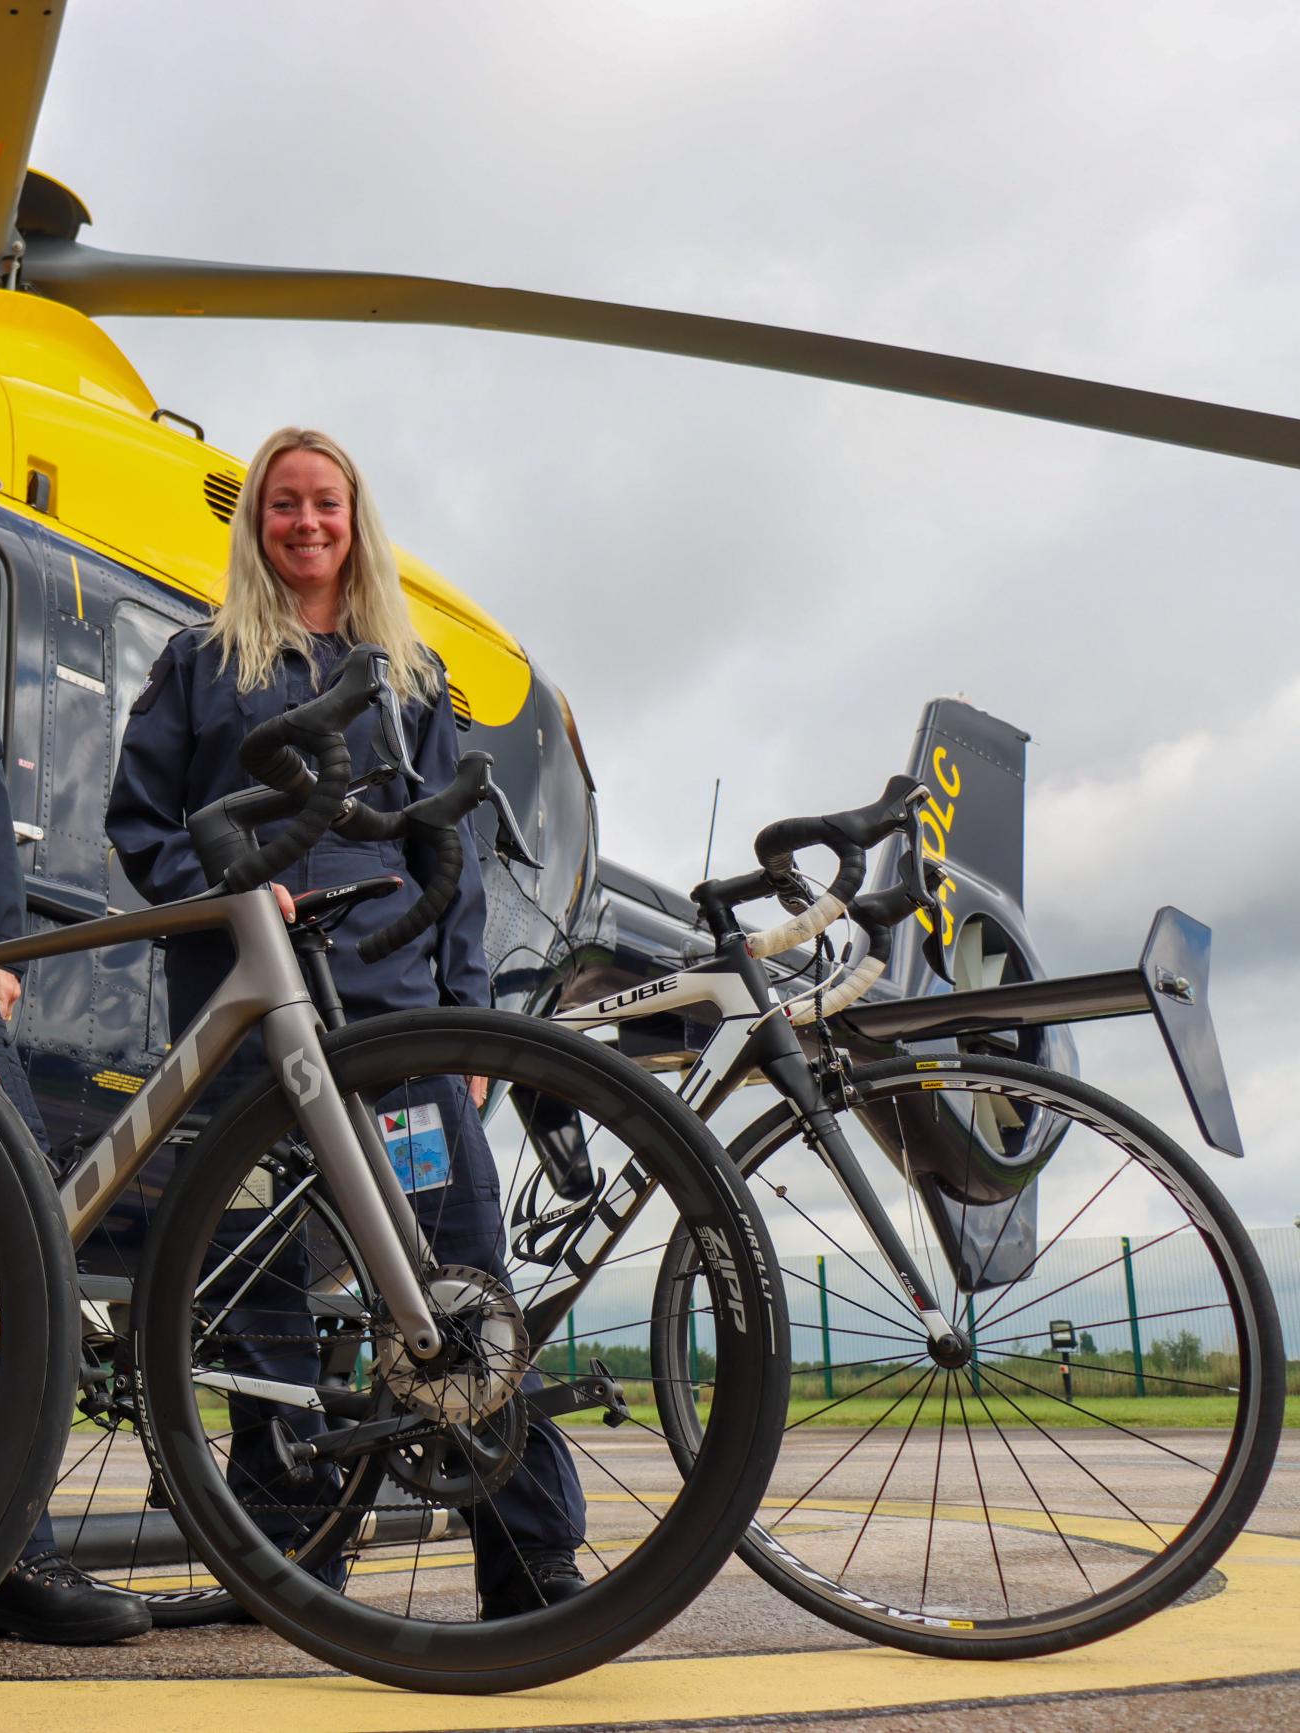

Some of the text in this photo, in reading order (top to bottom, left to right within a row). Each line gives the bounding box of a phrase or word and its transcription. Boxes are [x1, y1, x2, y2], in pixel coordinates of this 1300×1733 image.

[326, 884, 357, 899] CUBE
[598, 976, 678, 1014] CUBE
[706, 1226, 747, 1334] ZIPP
[738, 1213, 773, 1300] PIRELLI
[138, 1395, 157, 1452] ZERO
